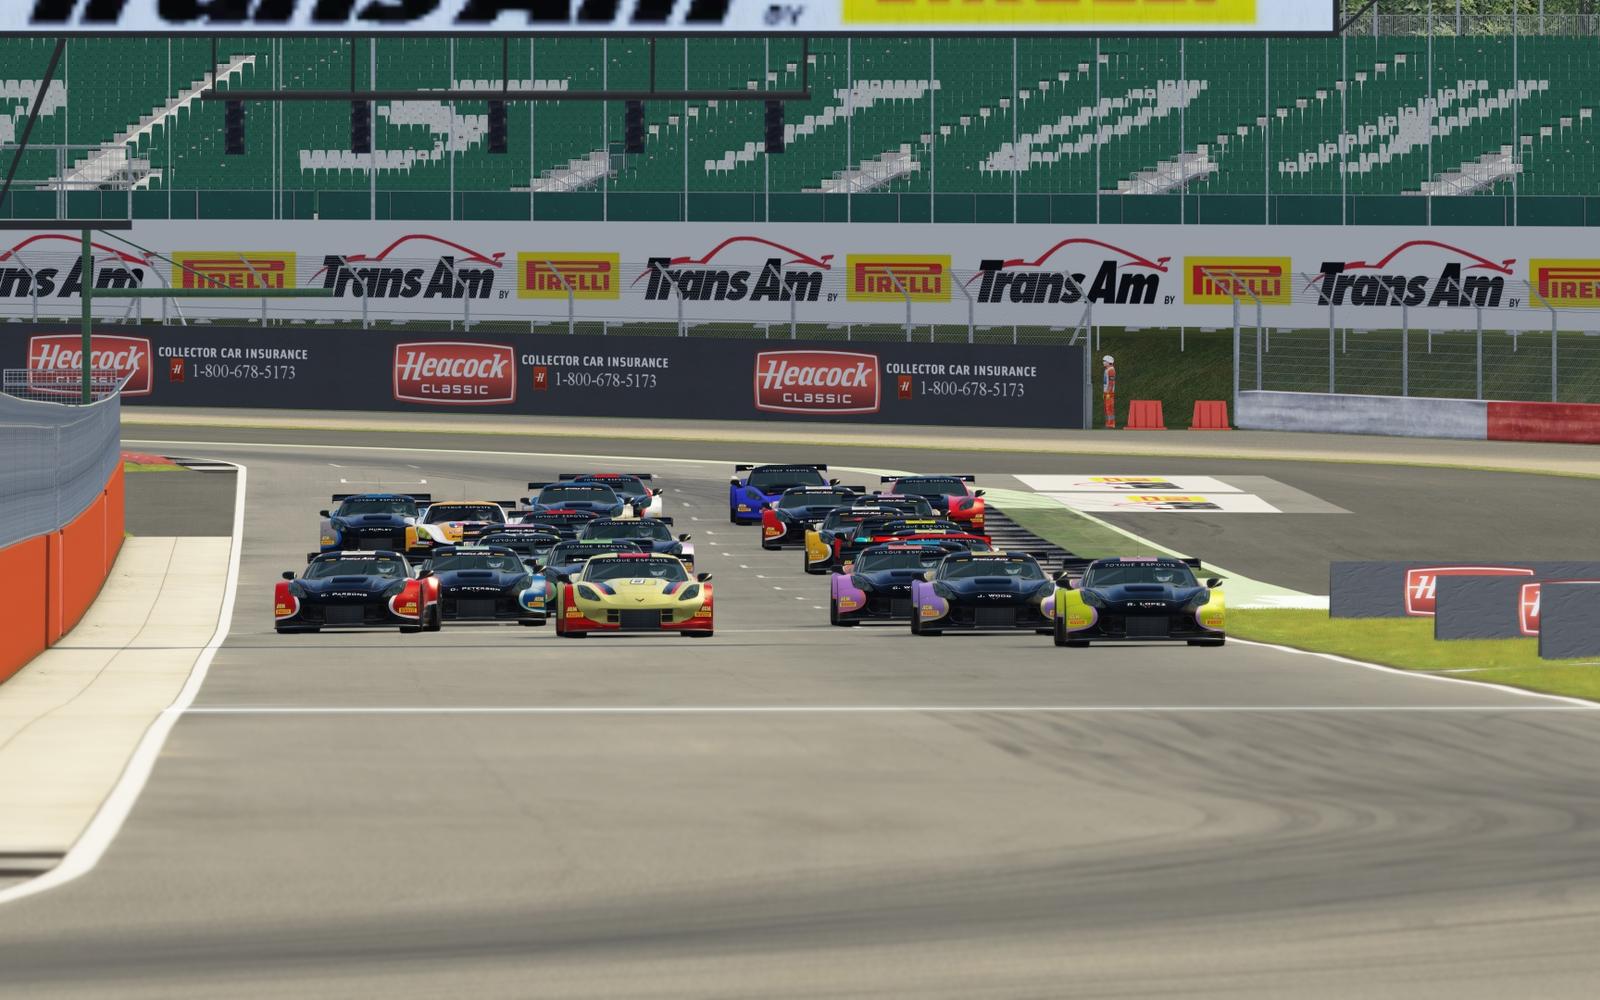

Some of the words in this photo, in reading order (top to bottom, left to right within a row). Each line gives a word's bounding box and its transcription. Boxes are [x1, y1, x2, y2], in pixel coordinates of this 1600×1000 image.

[182, 260, 285, 289] PIRELLI
[526, 261, 611, 290] PIRELLI
[856, 263, 942, 293] PIRELLI
[1193, 265, 1282, 295] PIRELLI
[1538, 267, 1600, 298] PIRE
[498, 290, 510, 299] BY
[827, 293, 838, 302] BY
[1164, 295, 1175, 304] BY
[1508, 298, 1520, 307] BY
[158, 346, 216, 358] COLLECTOR
[220, 347, 241, 359] CAR
[245, 348, 308, 360] INSURANCE
[521, 354, 580, 366] COLLECTOR
[583, 356, 604, 367] CAR
[607, 356, 669, 368] INSURANCE
[192, 364, 296, 380] 1-800-678-5173
[399, 351, 508, 380] Heacock
[886, 363, 944, 375] COLLECTOR
[949, 364, 970, 376] CAR
[974, 365, 1037, 377] INSURANCE
[555, 372, 657, 388] 1-800-678-5173
[760, 360, 872, 389] Heacock
[421, 383, 489, 395] CLASSIC
[921, 381, 1025, 398] 1-800-678-5173
[782, 392, 853, 404] CLASSIC
